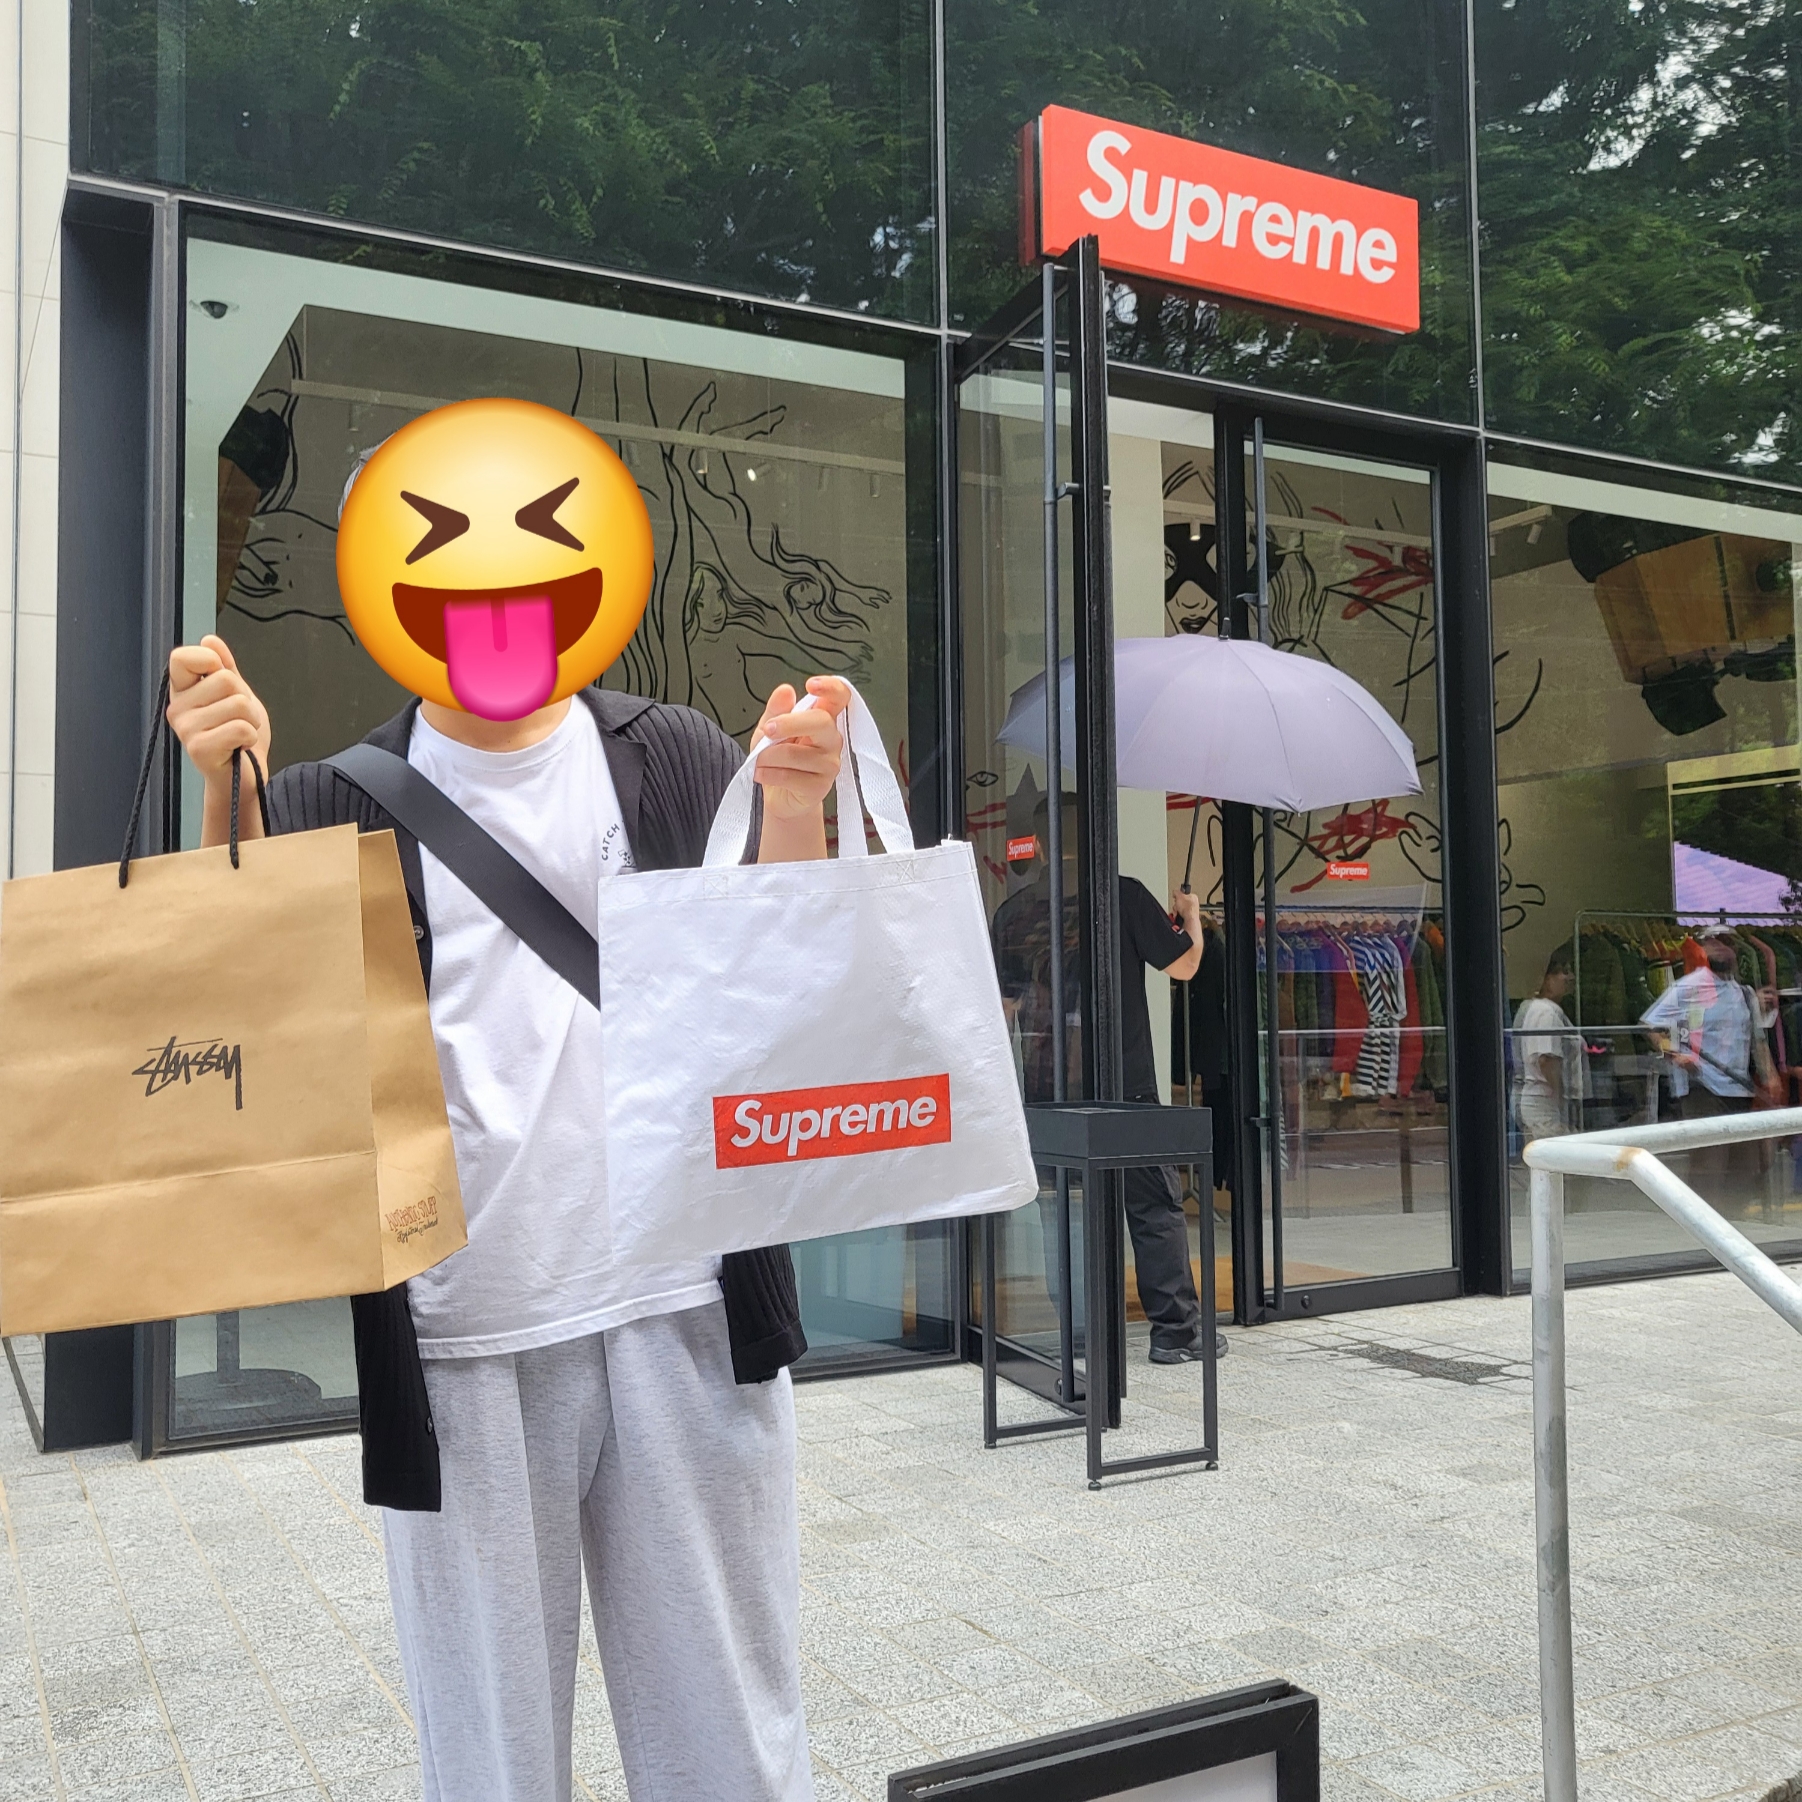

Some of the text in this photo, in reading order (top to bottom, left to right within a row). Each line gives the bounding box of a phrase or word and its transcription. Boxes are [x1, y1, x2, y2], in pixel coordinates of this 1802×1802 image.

[1078, 130, 1398, 284] Supreme
[601, 823, 620, 861] CATCH
[1008, 841, 1034, 859] Supreme
[1330, 863, 1368, 879] Supreme
[730, 1096, 937, 1157] Supreme
